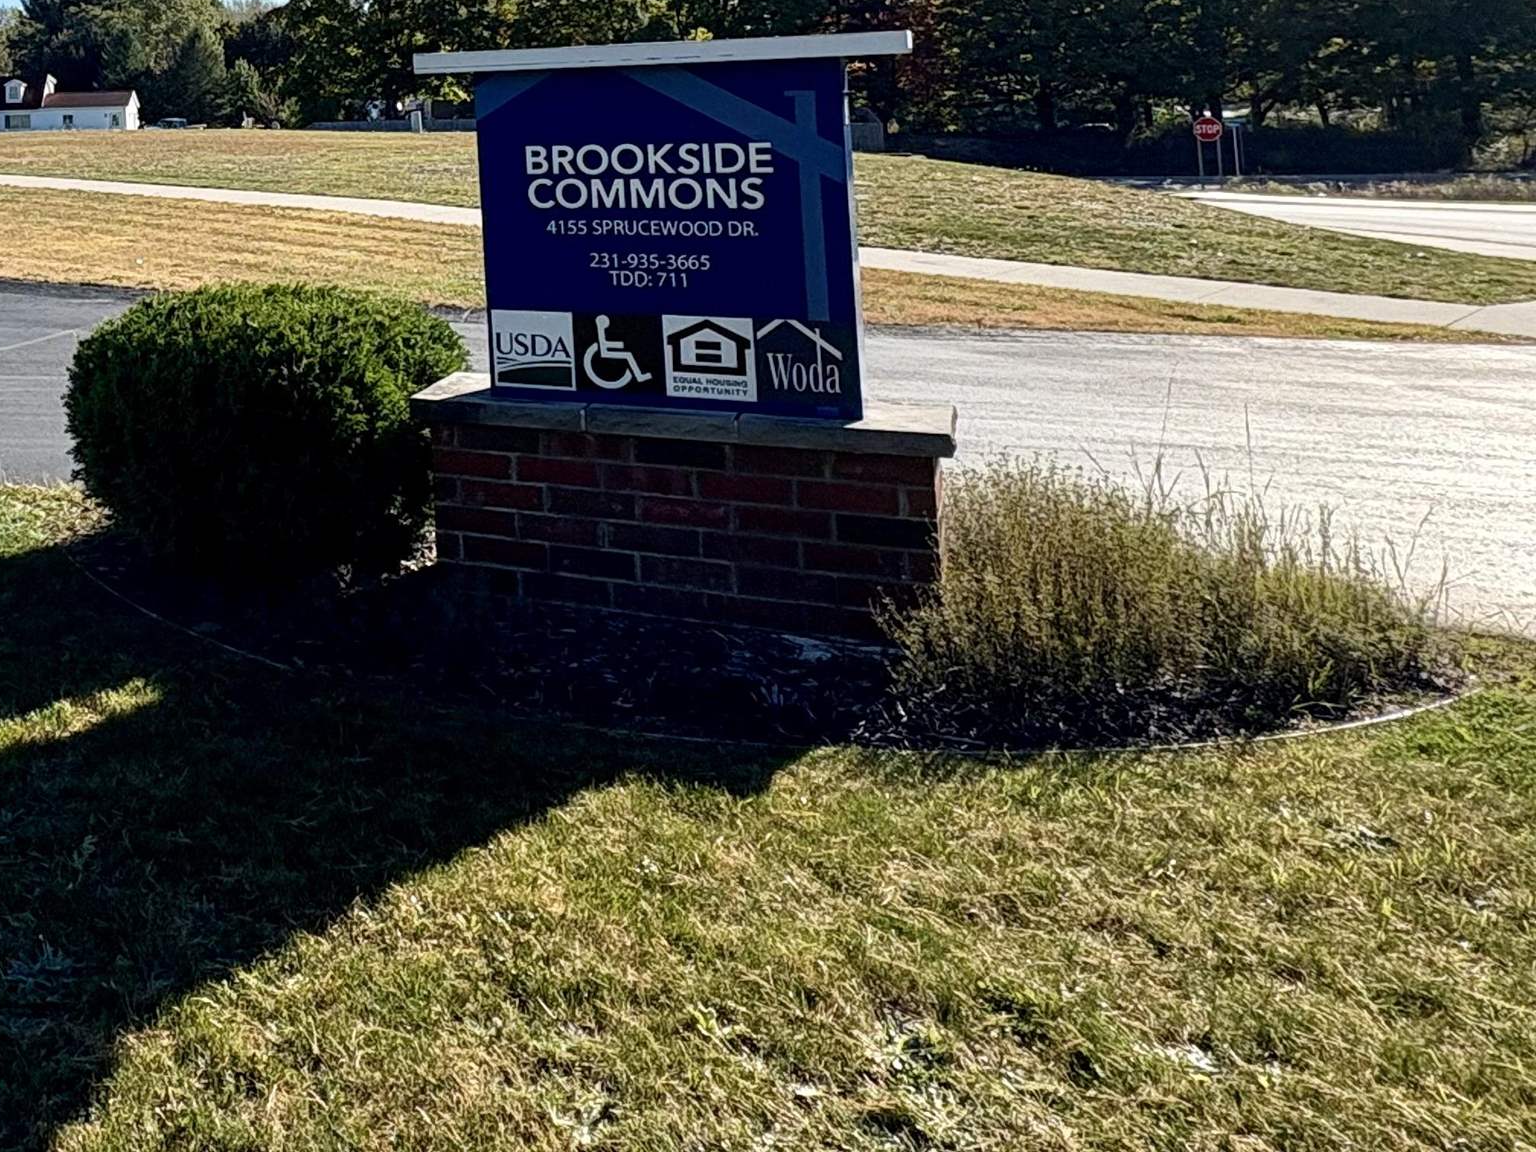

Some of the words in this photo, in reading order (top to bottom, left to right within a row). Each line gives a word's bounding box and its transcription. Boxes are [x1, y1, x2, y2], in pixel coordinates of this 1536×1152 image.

[1195, 124, 1220, 134] STOP
[525, 142, 774, 176] BROOKSIDE
[528, 177, 765, 210] COMMONS
[546, 220, 587, 235] 4155
[592, 219, 722, 237] SPRUCEWOOD
[728, 220, 759, 237] DR.
[589, 252, 710, 270] 231-935-3665
[609, 271, 653, 287] TDD:
[657, 272, 688, 288] 711
[495, 332, 572, 358] USDA
[766, 334, 842, 394] Woda
[673, 376, 703, 385] EQUAL
[706, 378, 748, 388] HOUSING
[673, 384, 748, 396] OPPORTUNITY
